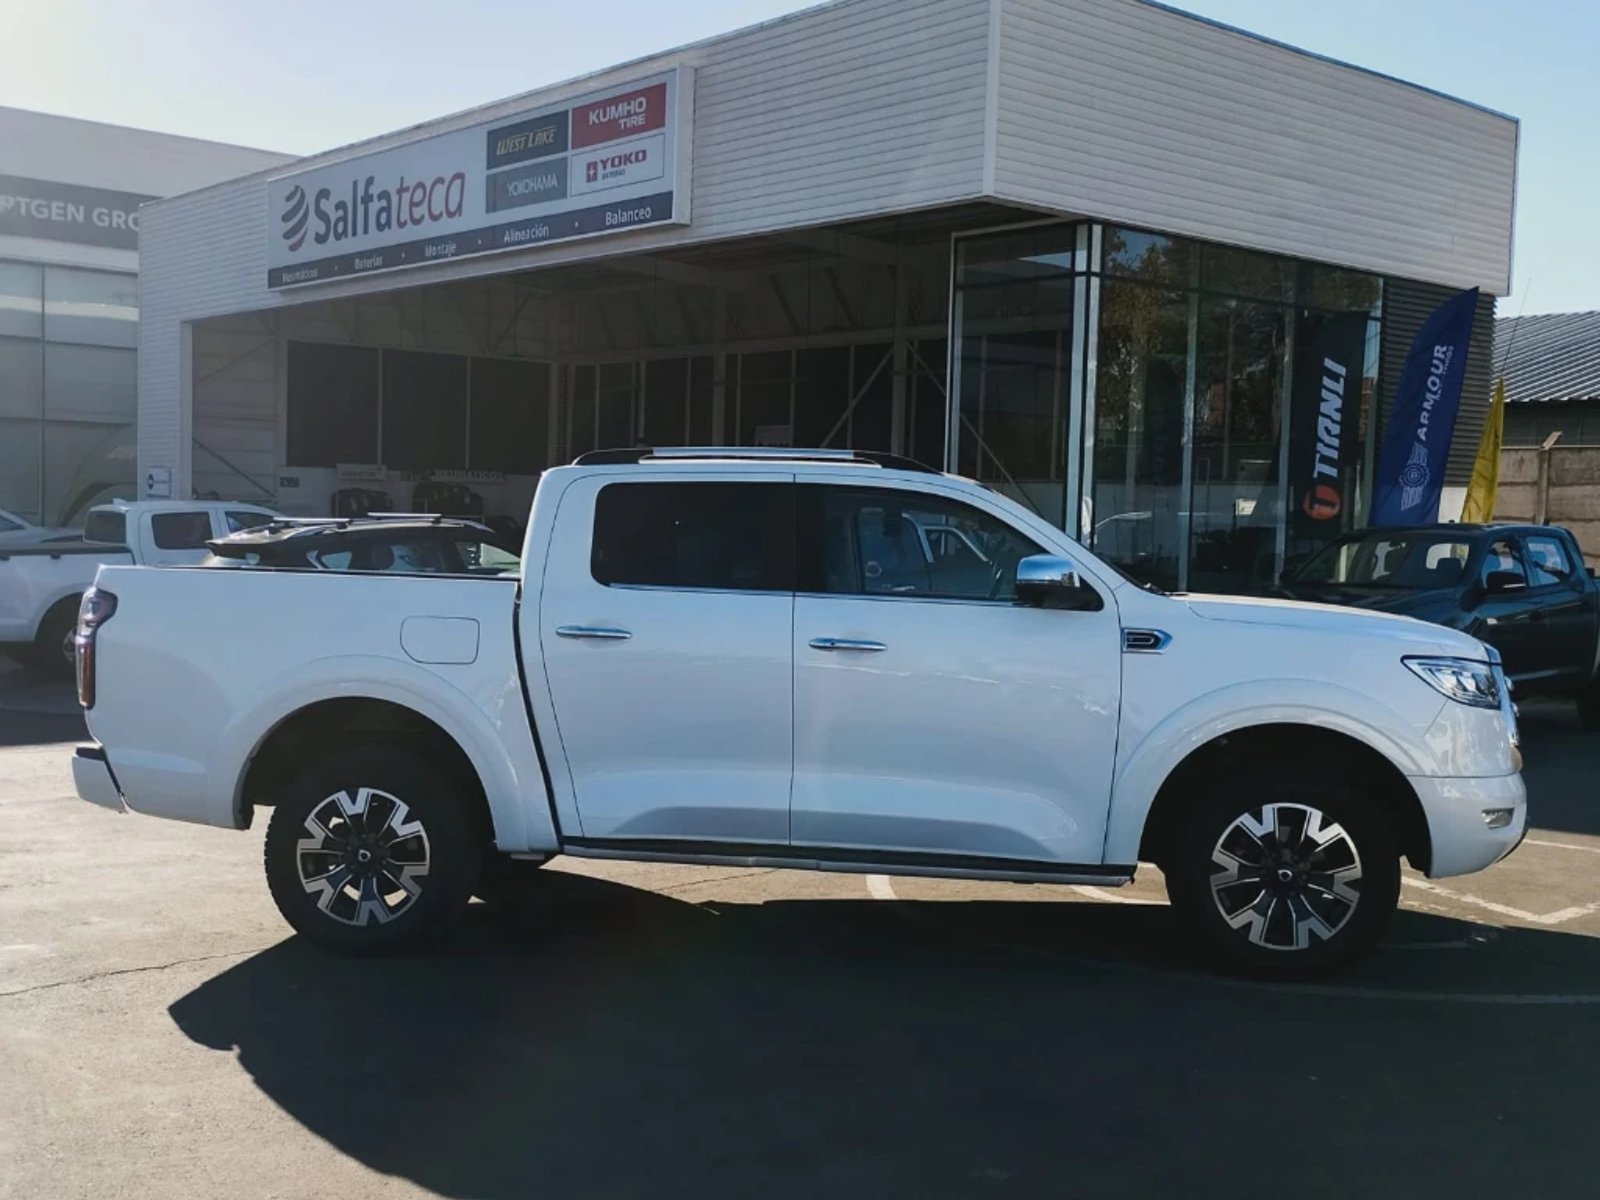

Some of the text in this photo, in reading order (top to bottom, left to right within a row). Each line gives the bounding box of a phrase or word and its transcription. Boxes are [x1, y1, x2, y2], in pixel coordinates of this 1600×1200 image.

[589, 97, 647, 125] KUMHO
[619, 113, 647, 130] TIRE
[496, 127, 557, 155] WEST LAKE
[600, 150, 647, 170] YOKO
[507, 173, 559, 197] YOKOHAMA
[313, 172, 466, 245] Salfateca
[425, 240, 457, 258] Montaje
[504, 224, 550, 244] Alineación
[606, 206, 652, 226] Balanceo
[1417, 344, 1448, 441] ARMOUR
